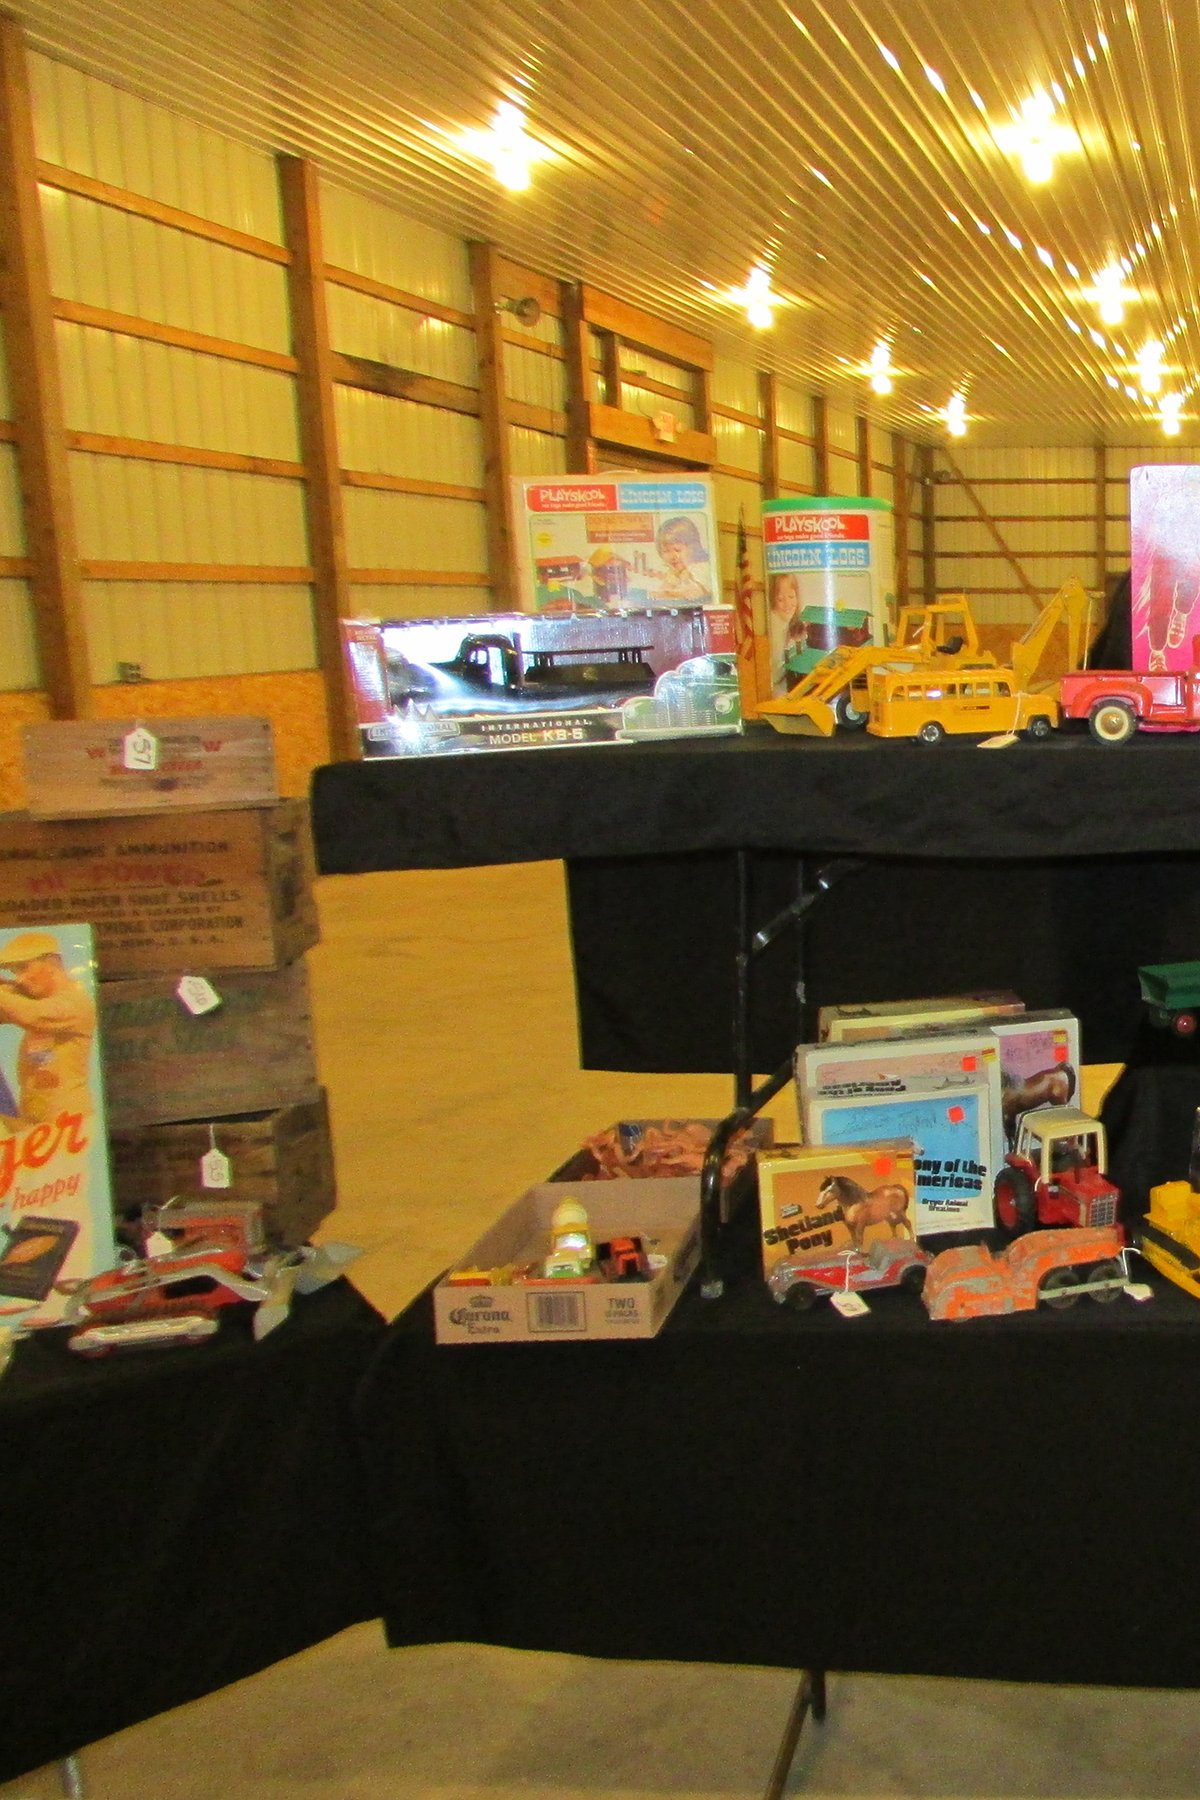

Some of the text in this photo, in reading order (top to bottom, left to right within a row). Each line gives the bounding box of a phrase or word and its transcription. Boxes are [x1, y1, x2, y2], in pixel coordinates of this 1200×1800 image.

[540, 487, 605, 502] PLAYSKOOL
[775, 515, 846, 533] PLAYSKOOL
[767, 548, 822, 568] LINCOLN
[481, 718, 592, 731] INTERNATIONAL
[489, 733, 536, 746] MODEL
[115, 841, 229, 856] AMMUNITION
[178, 889, 241, 902] SHELLS
[912, 1159, 987, 1177] ony of the
[916, 1174, 983, 1190] mericas
[12, 1174, 82, 1211] happy
[764, 1205, 846, 1245] Shetland
[786, 1229, 833, 1255] Pony
[608, 1297, 635, 1308] TWO
[449, 1306, 511, 1327] Corona
